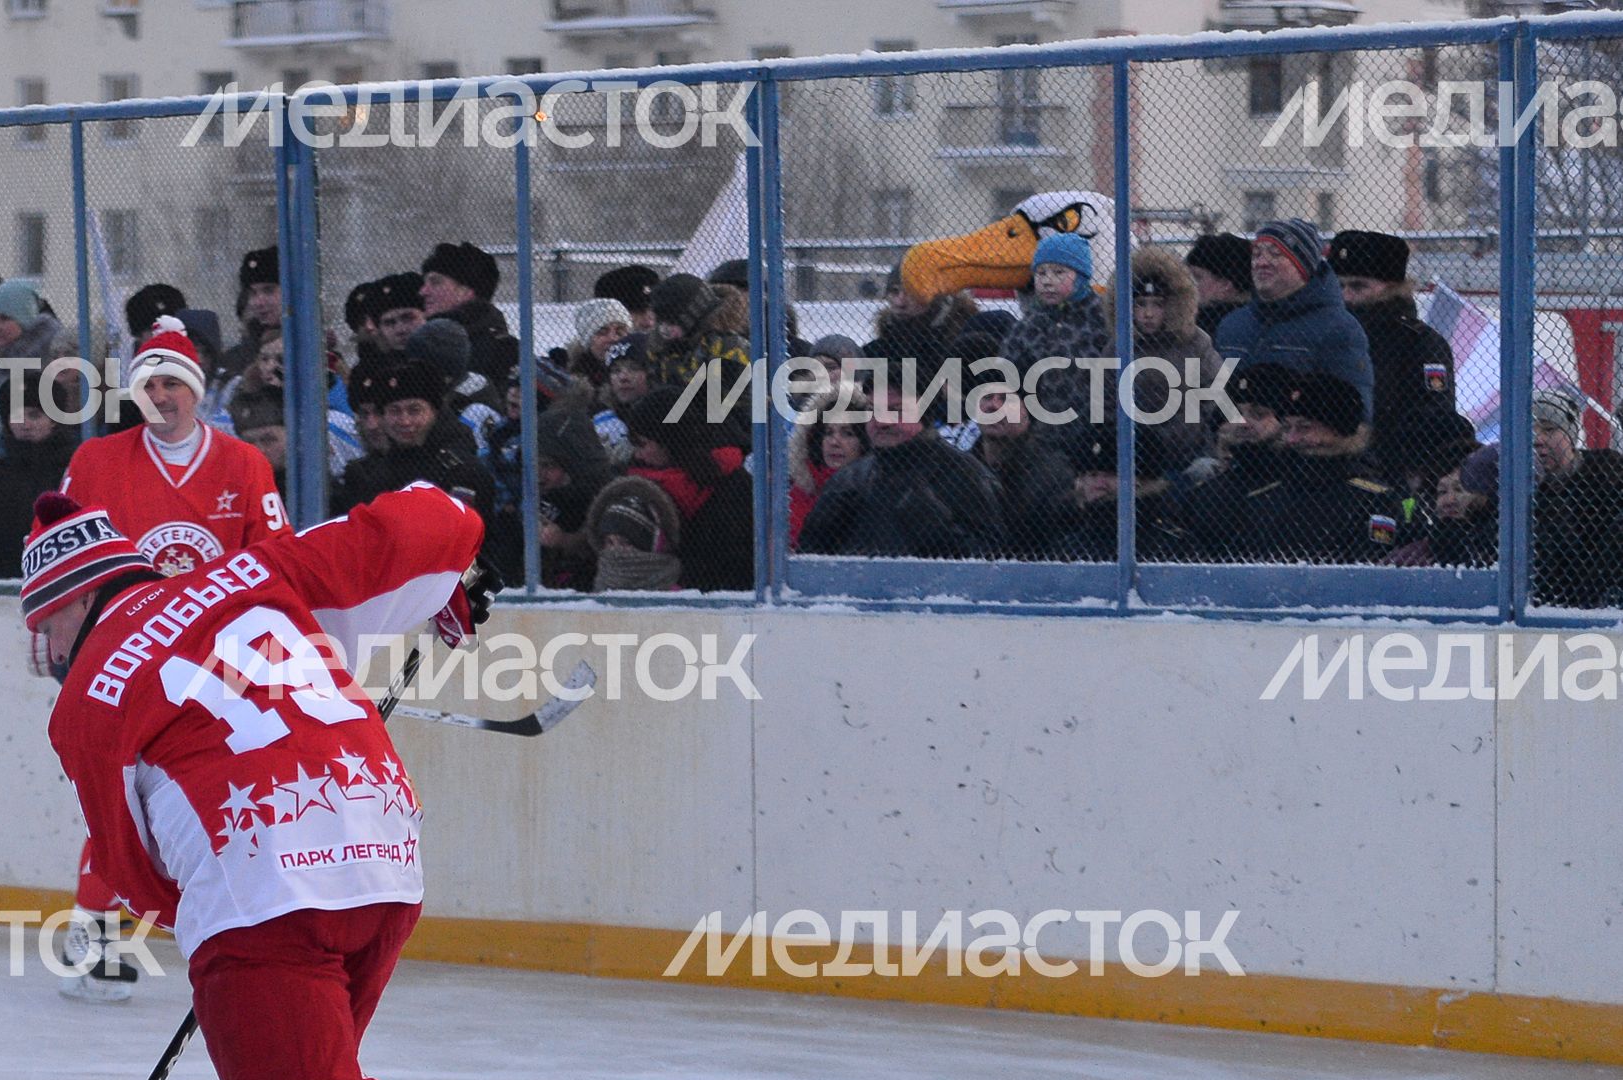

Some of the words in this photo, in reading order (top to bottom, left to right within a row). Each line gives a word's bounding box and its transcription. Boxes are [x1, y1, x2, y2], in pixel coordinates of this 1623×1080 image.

[87, 552, 271, 708] ВОРОБЬЕВ
[126, 587, 165, 616] LUTCH
[159, 605, 368, 755] 19
[279, 848, 336, 869] ПАРК
[341, 843, 403, 864] ЛЕГЕНД
